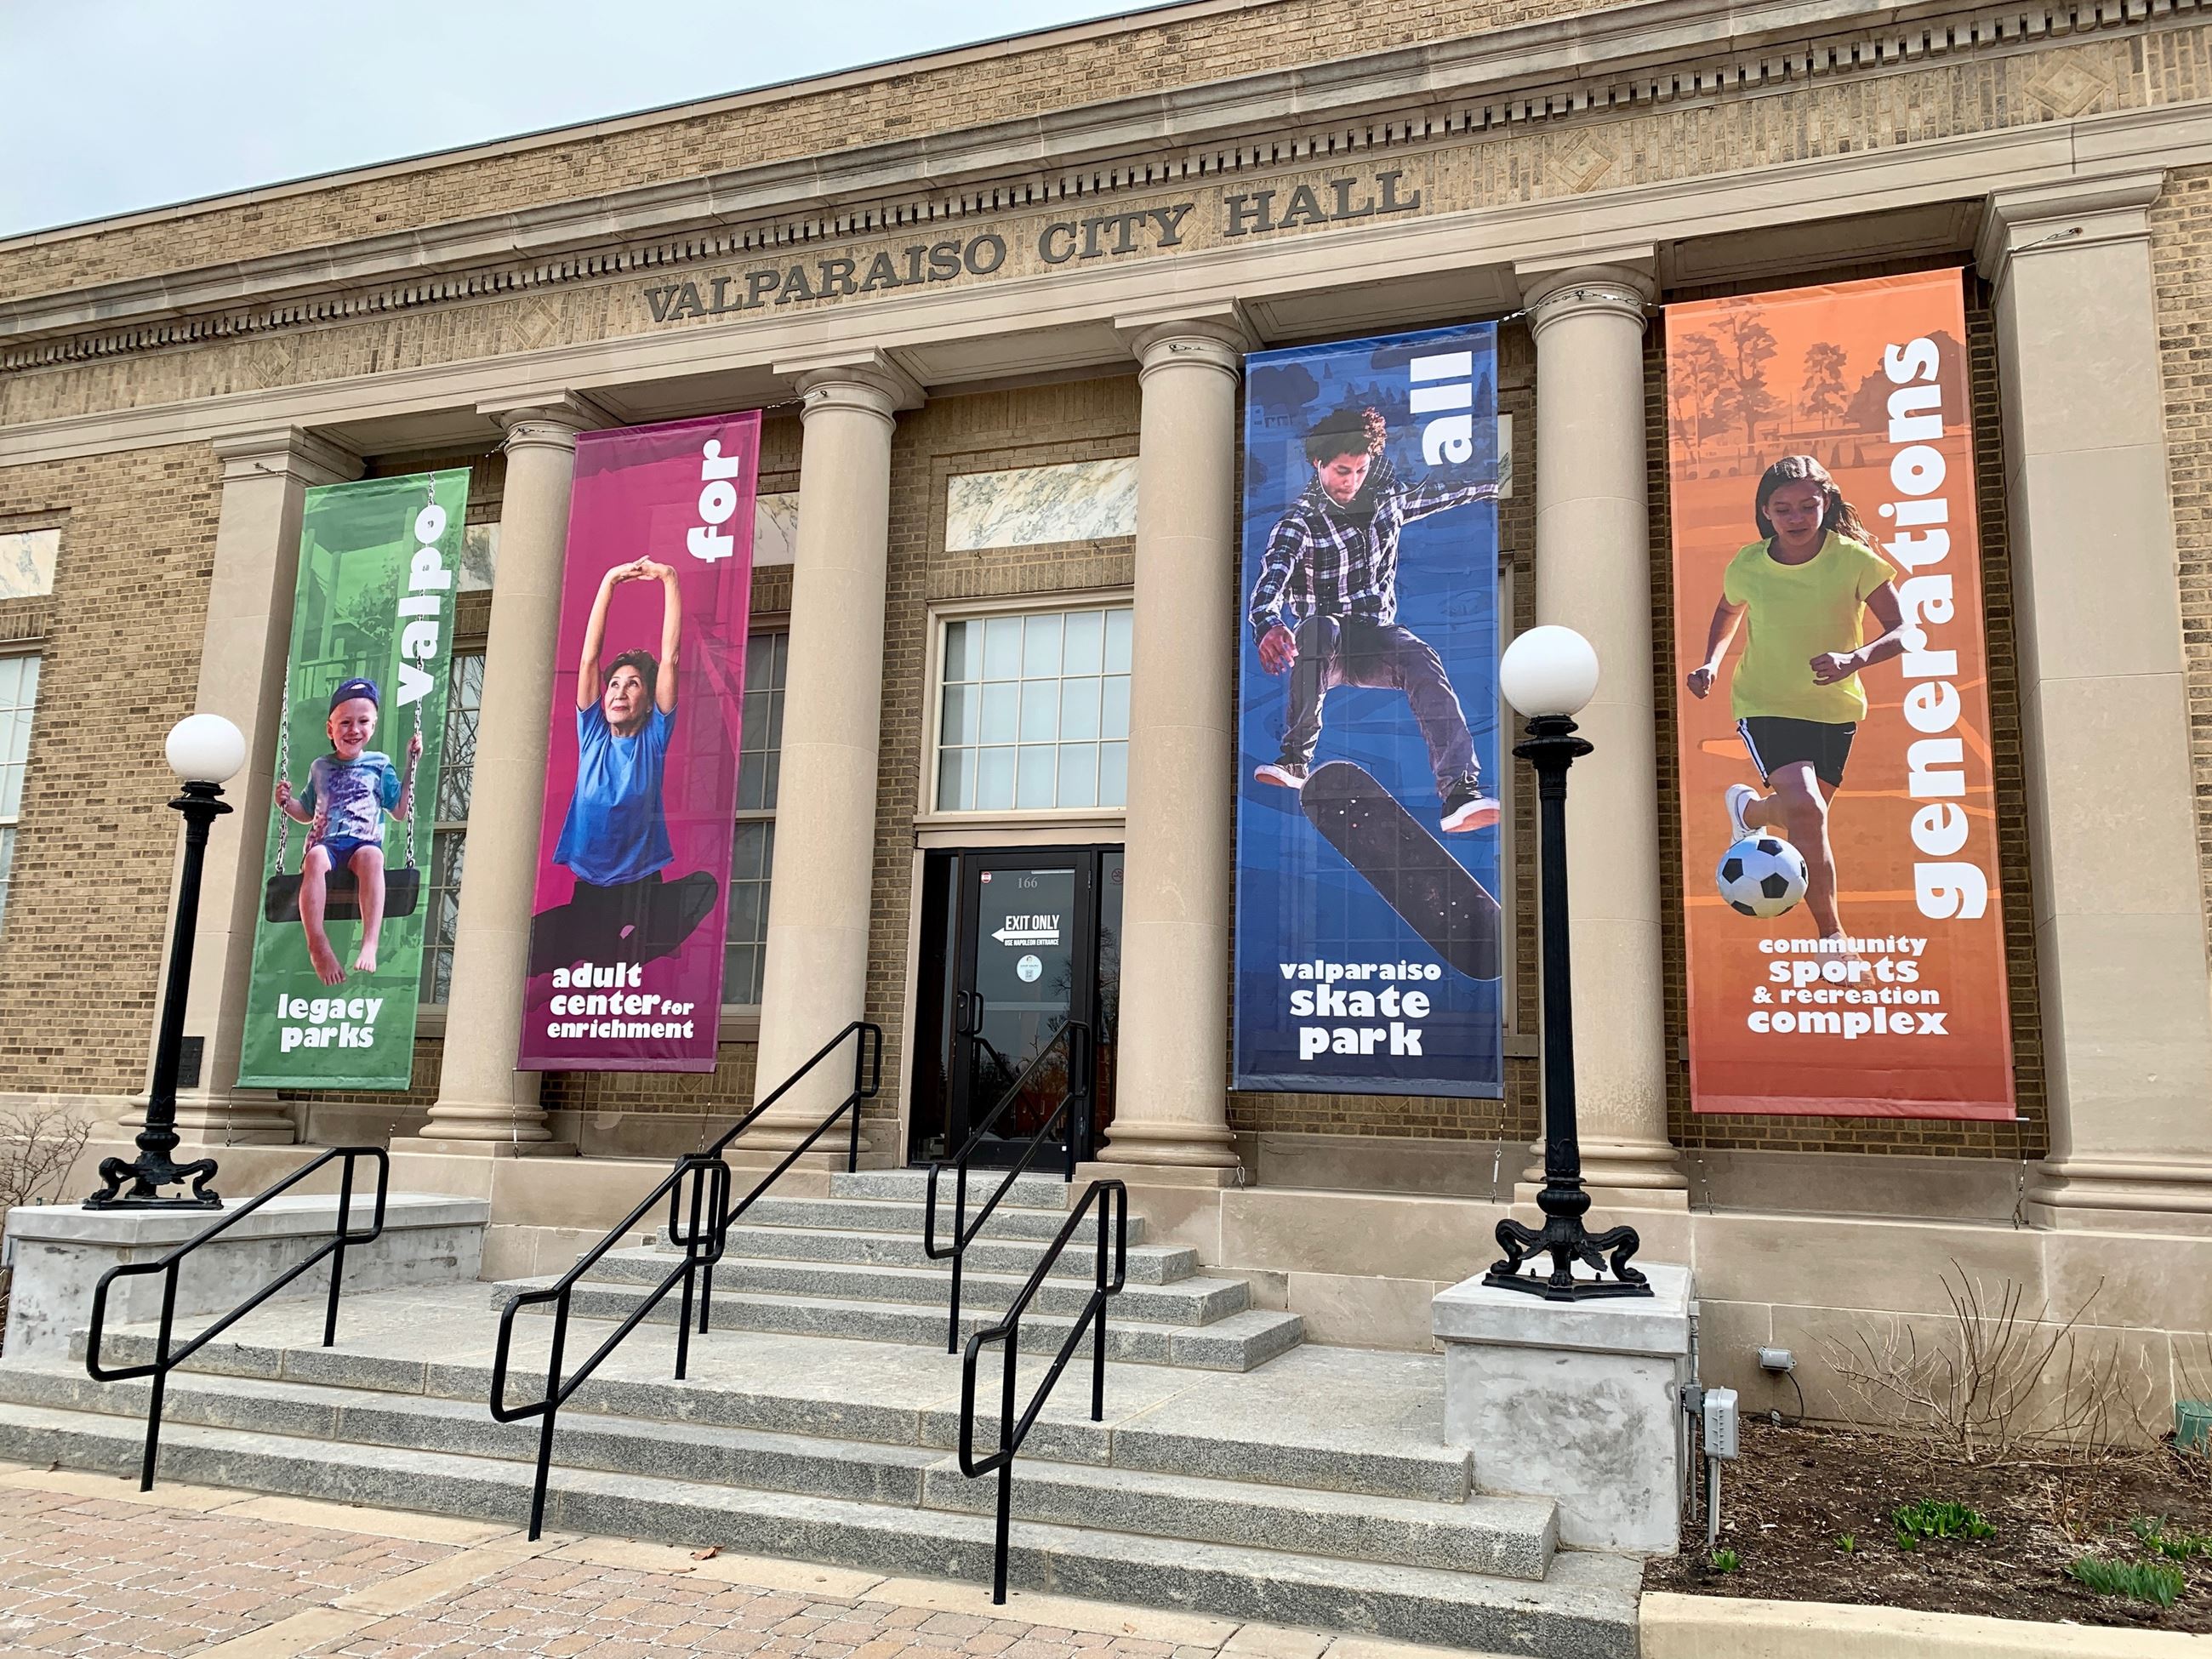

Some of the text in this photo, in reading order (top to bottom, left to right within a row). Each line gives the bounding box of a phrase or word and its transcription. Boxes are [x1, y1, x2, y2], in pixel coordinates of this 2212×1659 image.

[644, 170, 1421, 322] VALPARAISO CITY HALL
[1411, 351, 1473, 466] all
[687, 439, 739, 563] for
[396, 505, 452, 707] valpo
[1878, 338, 1987, 921] generations
[1018, 877, 1038, 889] 166
[1005, 915, 1060, 931] EXIT ONLY
[1759, 935, 1928, 956] community
[552, 962, 642, 988] adult
[1280, 960, 1441, 983] valparaiso
[1769, 955, 1919, 988] sports
[277, 994, 383, 1024] legacy
[550, 990, 694, 1016] center for
[1290, 983, 1430, 1018] skate
[1752, 985, 1940, 1005] & recreation
[281, 1022, 374, 1052] parks
[547, 1019, 694, 1039] enrichment
[1747, 1006, 1949, 1040] complex
[1299, 1022, 1422, 1060] park
